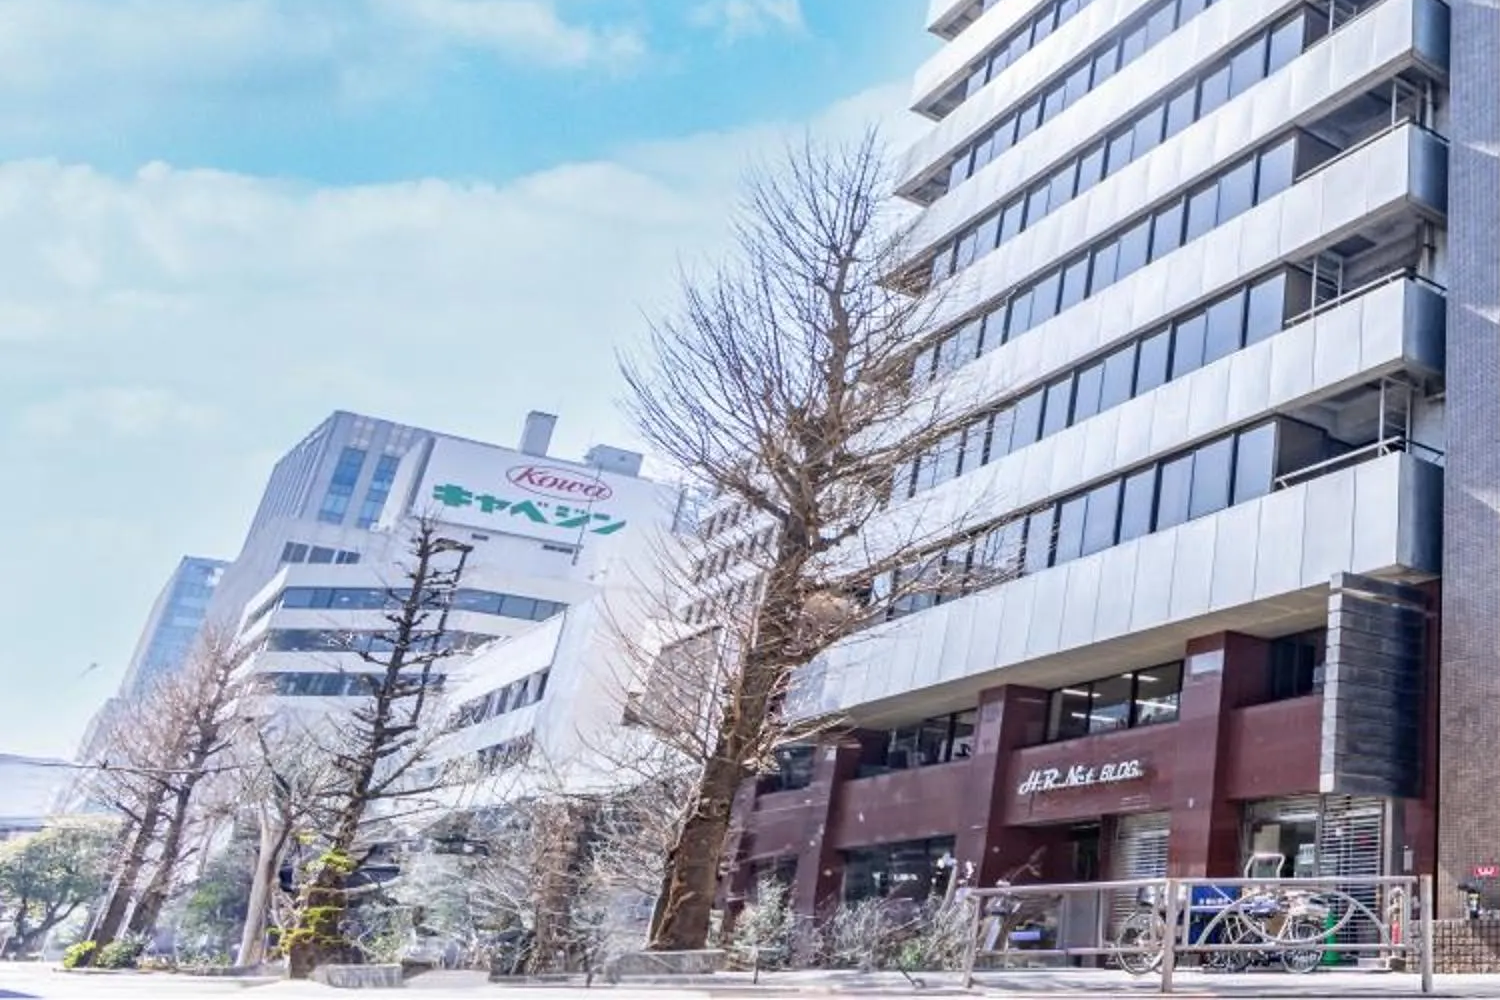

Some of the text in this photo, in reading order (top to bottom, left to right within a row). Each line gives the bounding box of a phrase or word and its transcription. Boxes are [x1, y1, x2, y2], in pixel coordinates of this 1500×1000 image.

[514, 467, 609, 499] Kowa
[432, 483, 627, 535] キャベジン
